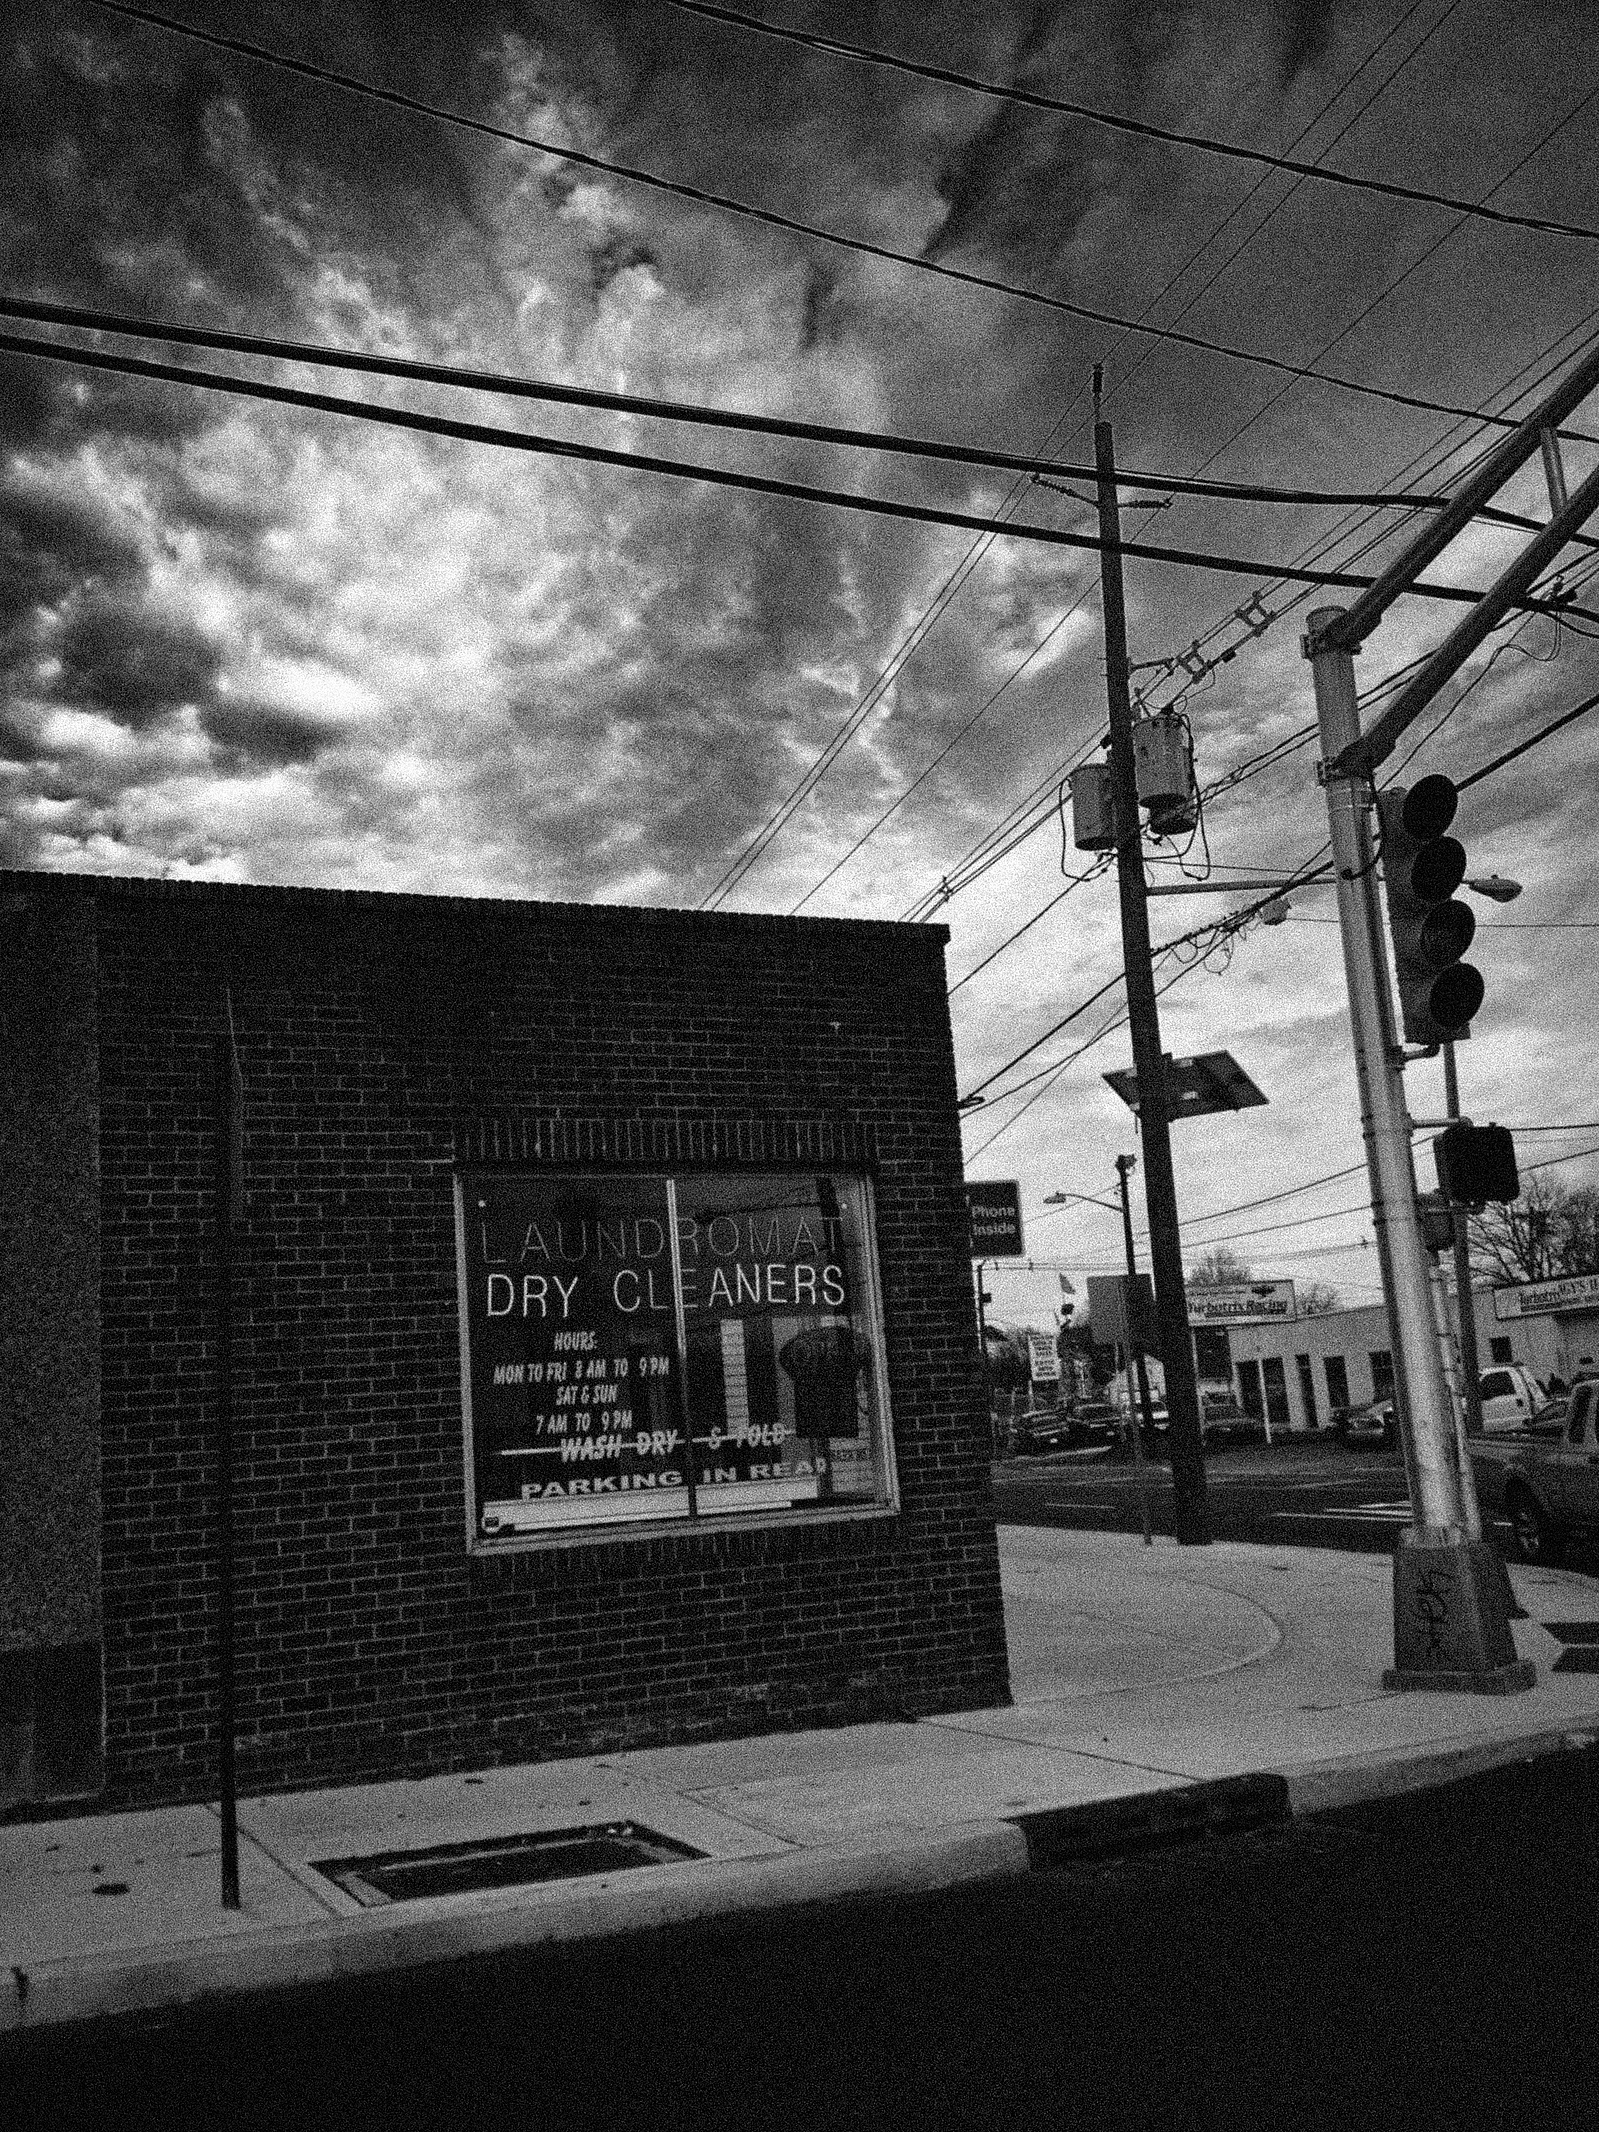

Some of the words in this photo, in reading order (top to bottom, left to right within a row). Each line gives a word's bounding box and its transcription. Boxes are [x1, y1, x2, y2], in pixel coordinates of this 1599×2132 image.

[971, 1206, 1016, 1219] Phone
[481, 1215, 844, 1264] LAUNDROMAT
[972, 1222, 1017, 1236] Inside
[486, 1272, 580, 1319] DRY
[612, 1262, 847, 1313] CLEANERS
[492, 1363, 525, 1385] MON
[527, 1362, 544, 1383] TO
[546, 1360, 569, 1382] FRI
[574, 1359, 583, 1380] 8
[585, 1358, 607, 1379] AM
[613, 1357, 630, 1378] TO
[638, 1355, 648, 1377] 9
[649, 1354, 671, 1376] PM
[555, 1384, 579, 1406] SAT
[579, 1384, 591, 1405] &
[592, 1383, 619, 1405] SUN
[535, 1413, 546, 1435] 7
[546, 1413, 569, 1435] AM
[574, 1412, 592, 1433] TO
[600, 1410, 611, 1432] 9
[612, 1409, 633, 1431] PM
[560, 1433, 623, 1463] WASH
[636, 1428, 679, 1456] DRY
[520, 1469, 684, 1500] PARKING
[702, 1466, 738, 1484] IN
